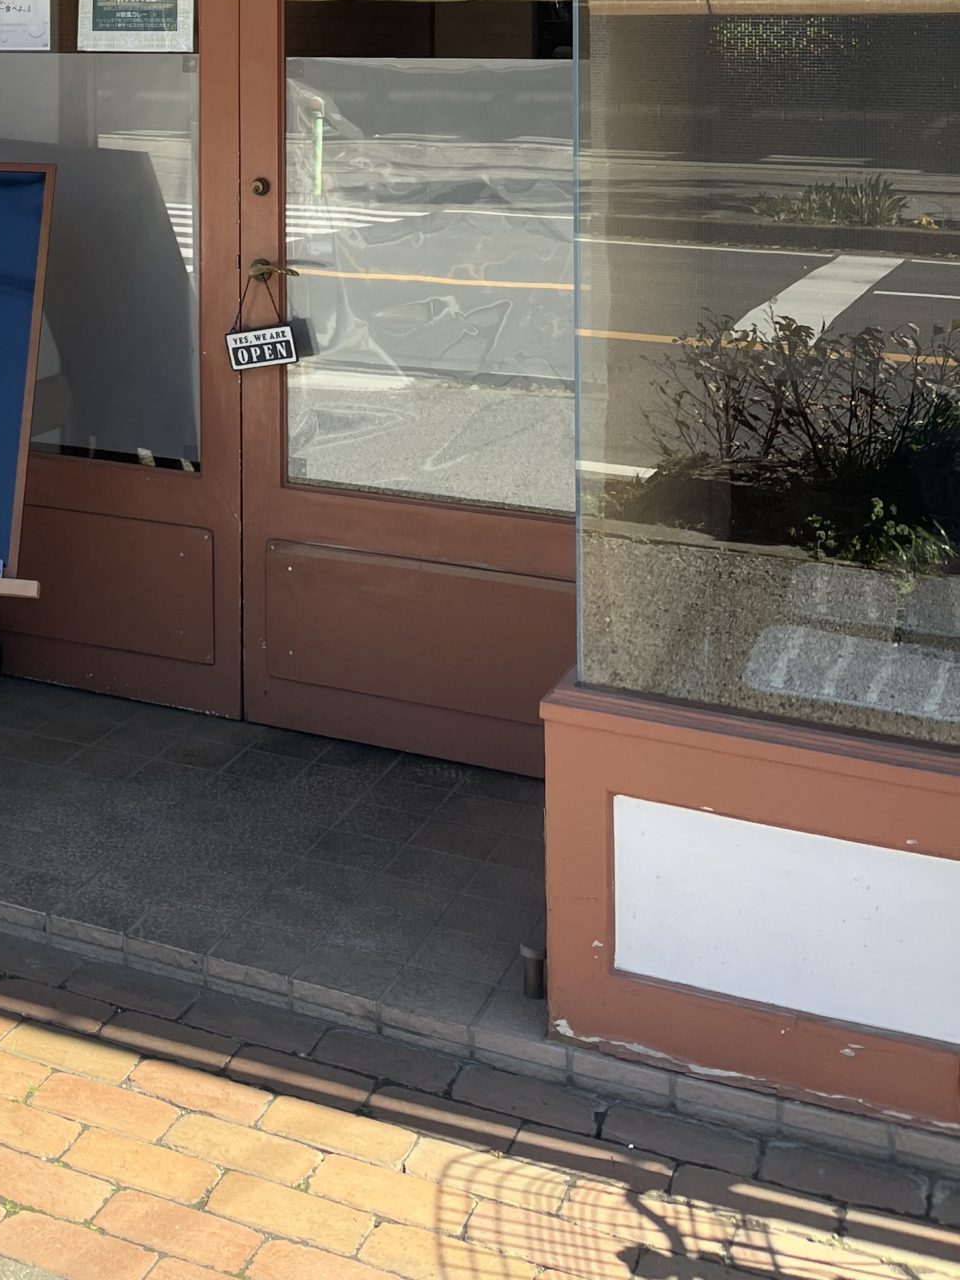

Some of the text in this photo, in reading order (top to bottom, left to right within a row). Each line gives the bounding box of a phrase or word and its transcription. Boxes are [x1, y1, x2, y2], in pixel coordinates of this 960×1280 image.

[233, 336, 253, 345] YES,
[270, 331, 287, 340] ARE
[237, 343, 287, 364] OPEN
